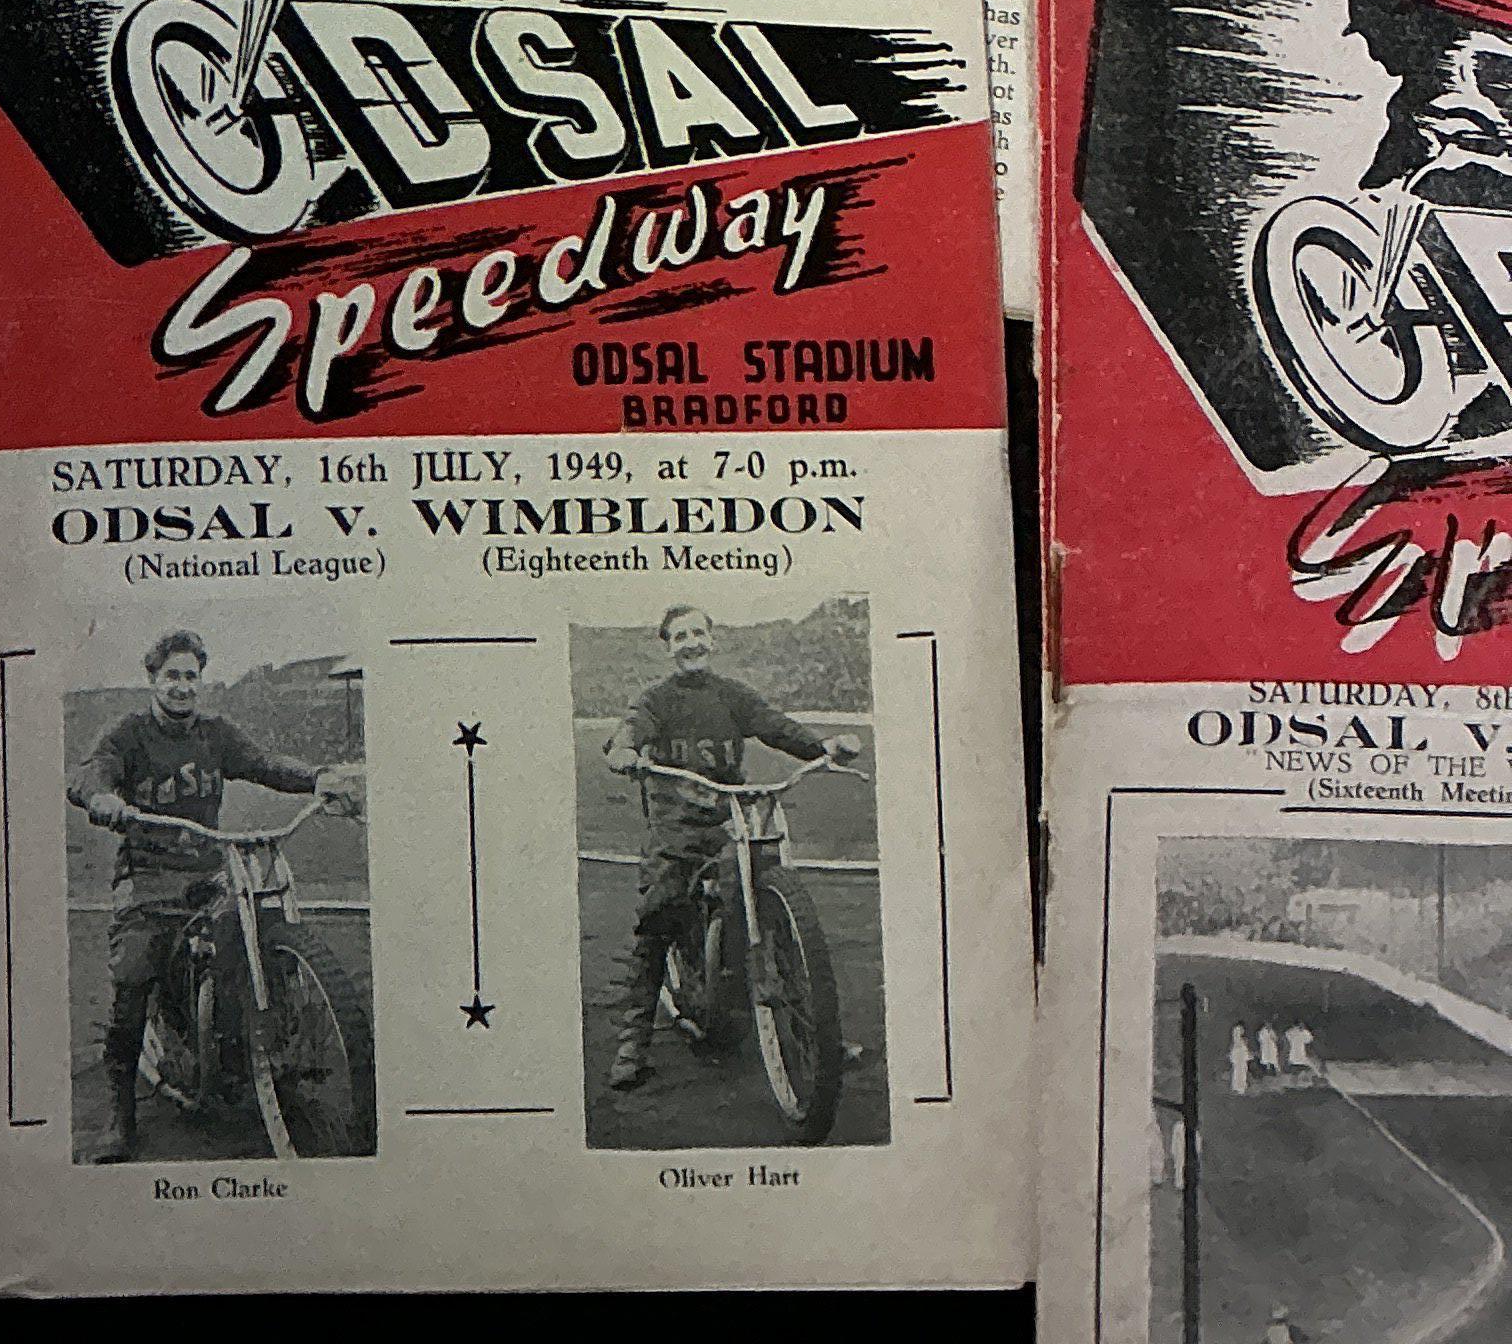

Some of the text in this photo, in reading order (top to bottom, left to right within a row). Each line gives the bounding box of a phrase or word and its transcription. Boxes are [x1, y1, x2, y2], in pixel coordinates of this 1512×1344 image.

[156, 185, 826, 416] Speedway
[571, 337, 936, 387] ODSAL STADIUM
[622, 392, 849, 427] BRADFORD
[51, 450, 858, 492] SATURDAY, 16th JULY, 1949, at p.m.
[50, 495, 866, 546] ODSAL WIMBLEDON
[124, 543, 794, 585] (National League) (Eighteenth Meeting)
[1187, 710, 1429, 752] ODSAL
[1427, 755, 1488, 779] THE
[1307, 778, 1426, 803] (Sixteenth
[153, 1174, 289, 1201] Ron Clarke
[658, 1165, 802, 1190] Oliver Hart
